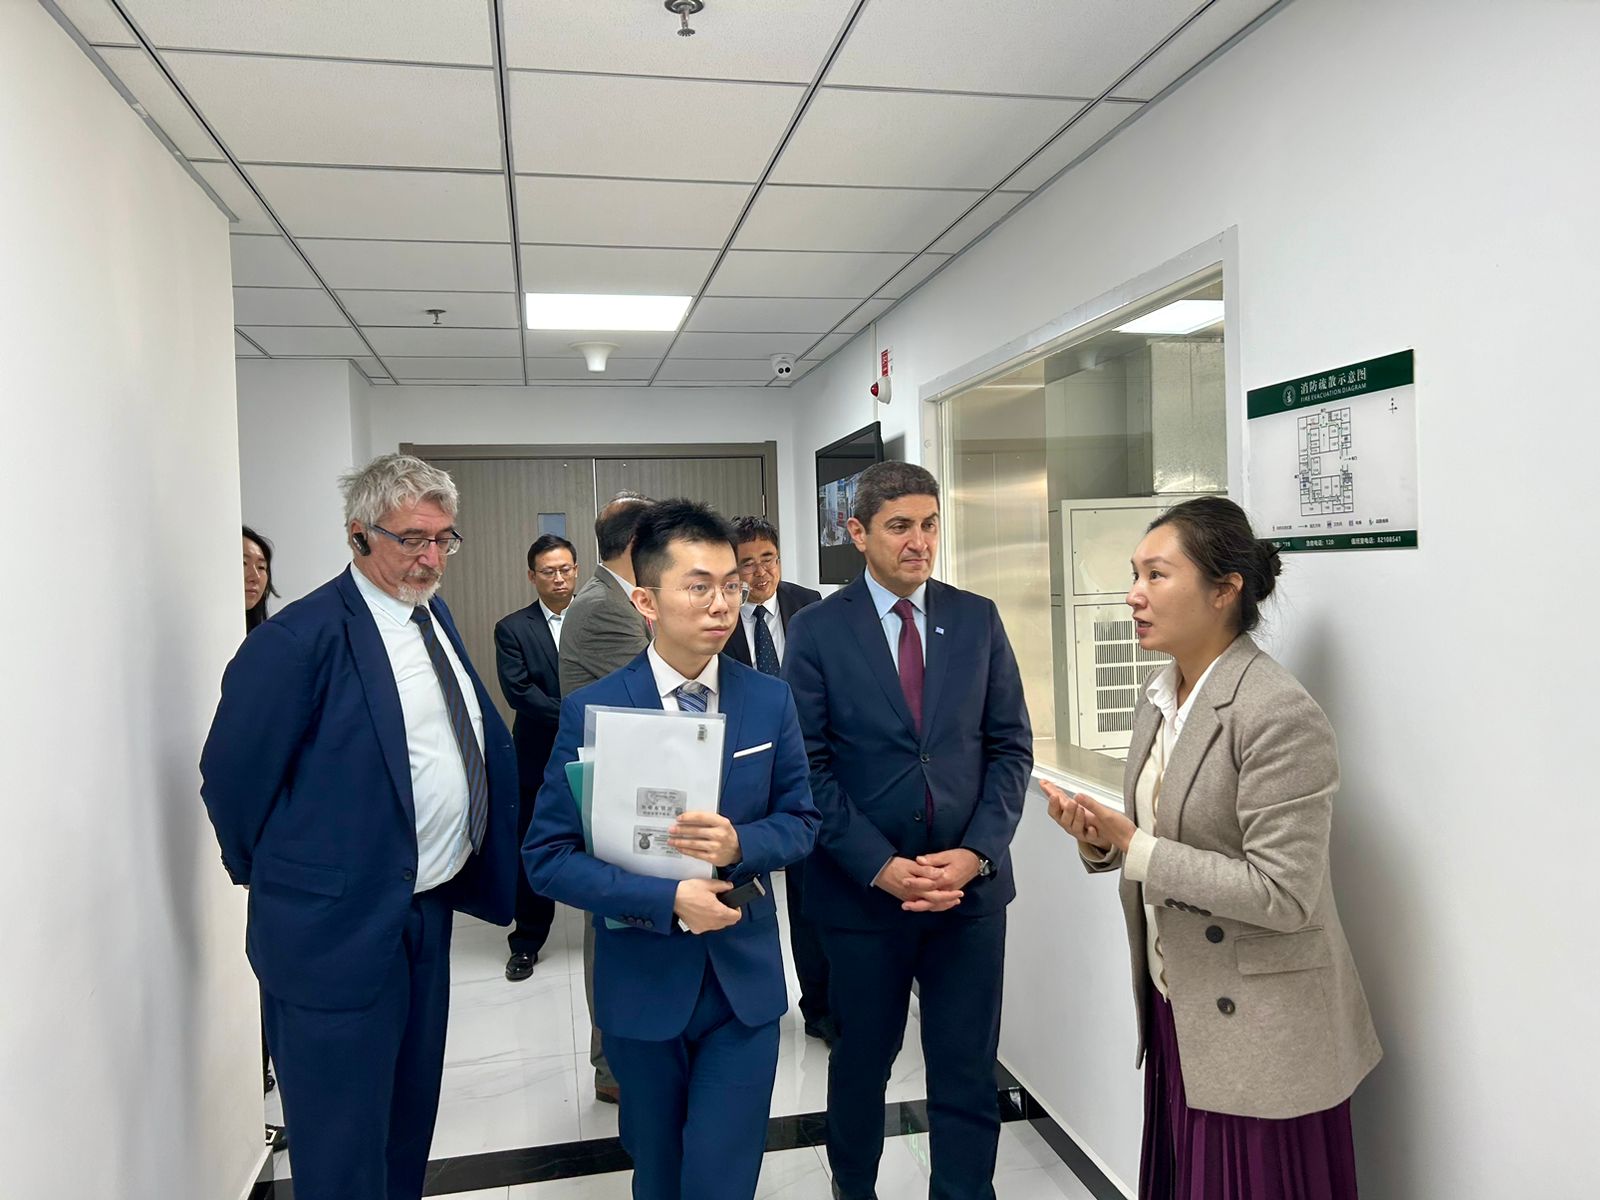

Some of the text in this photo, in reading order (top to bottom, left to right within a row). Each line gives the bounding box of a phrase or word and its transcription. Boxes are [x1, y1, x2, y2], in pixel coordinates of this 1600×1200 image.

[1300, 383, 1366, 402] FIRE EVACUATION DIAGRAM
[1301, 367, 1366, 395] 消防疏散示意图
